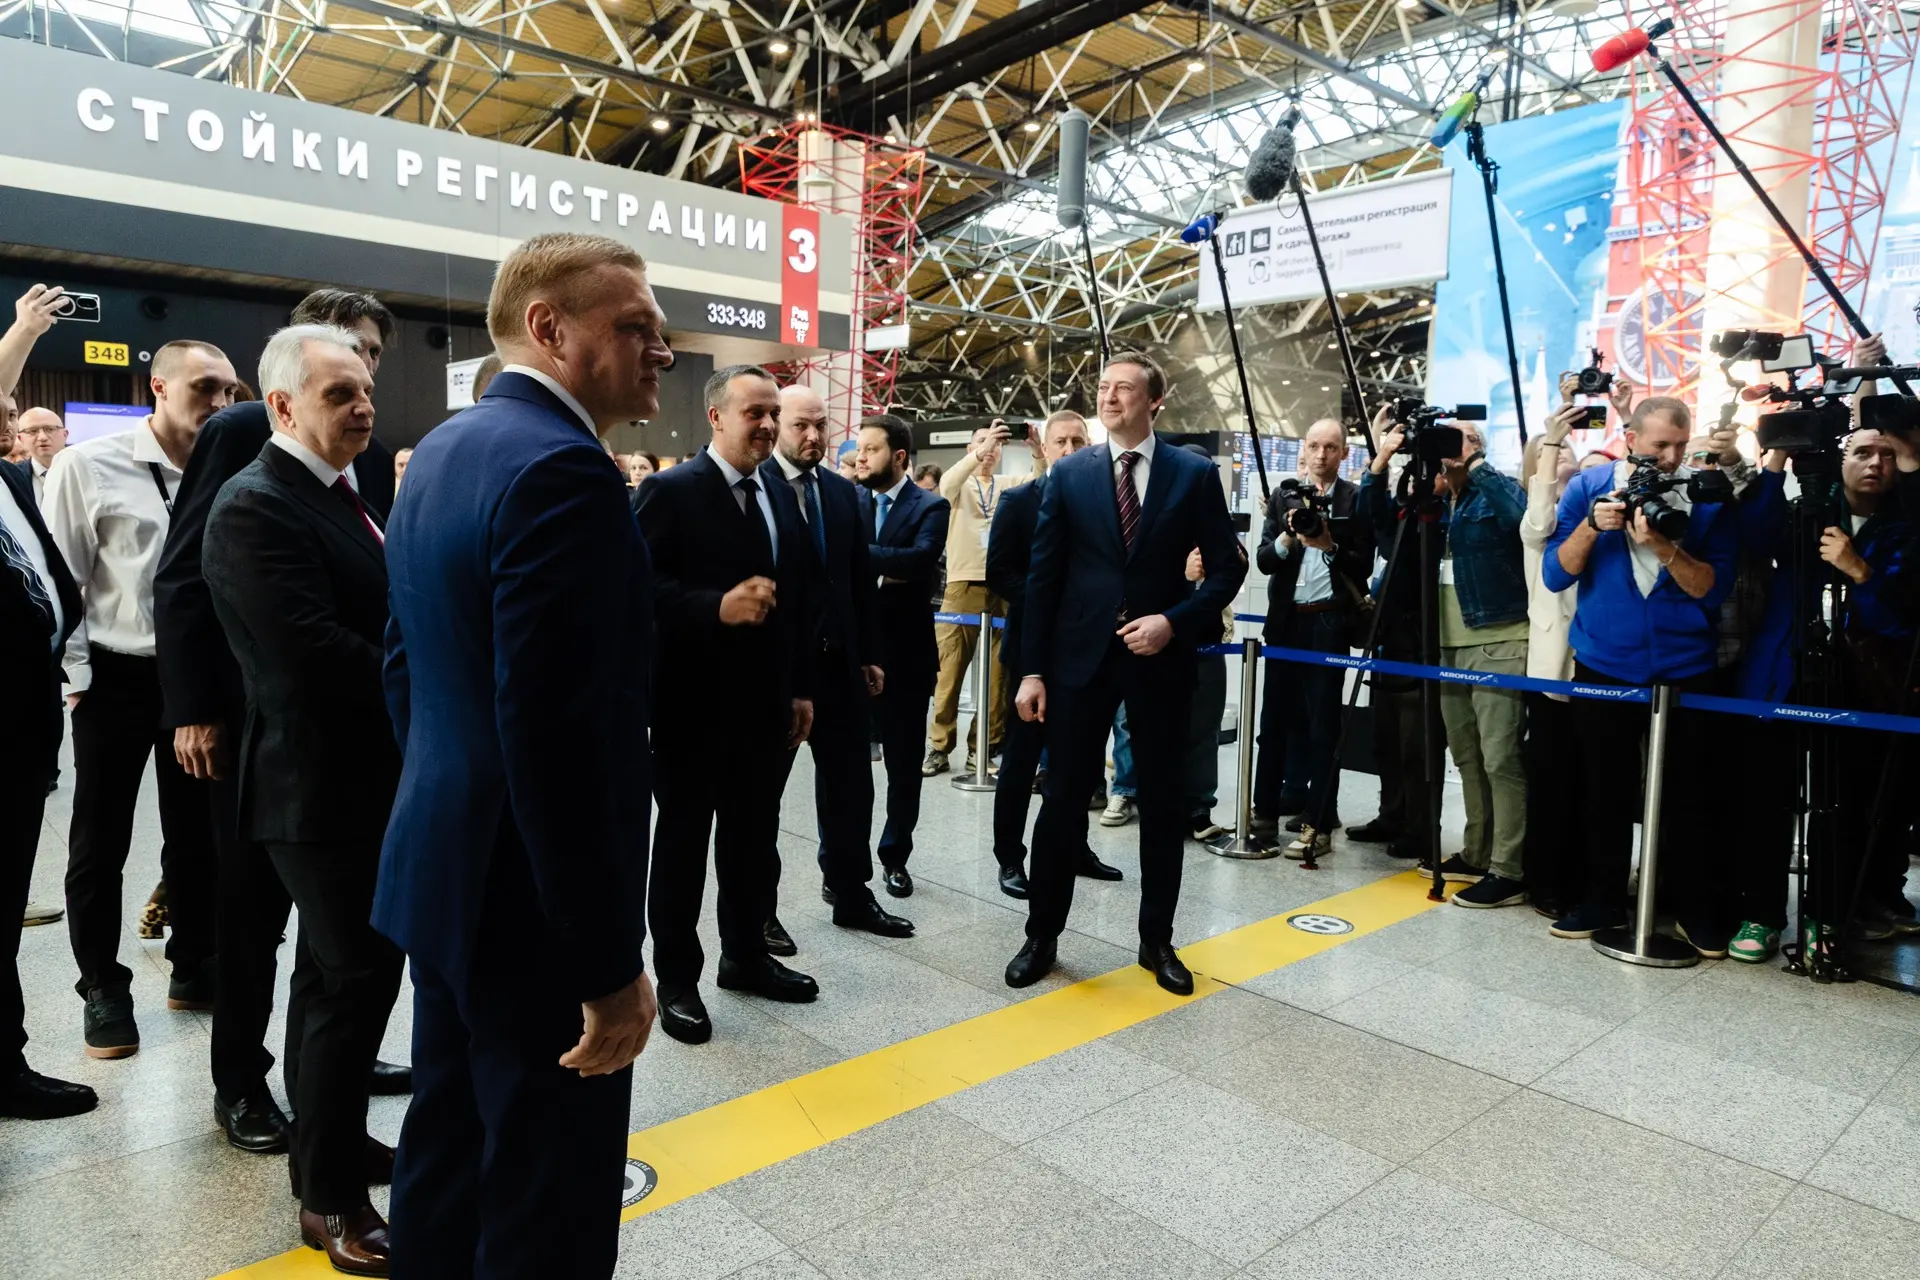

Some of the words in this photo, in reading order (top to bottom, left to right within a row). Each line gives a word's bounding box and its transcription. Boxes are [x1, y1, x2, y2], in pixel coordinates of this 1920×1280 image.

[76, 87, 369, 180] СТОЙКИ
[396, 148, 767, 252] РЕГИСТРАЦИИ
[1277, 214, 1365, 236] Самосоятельная
[1367, 201, 1438, 222] регистрация
[788, 227, 817, 273] 3
[707, 302, 766, 329] 333-348
[88, 345, 126, 362] 348
[1325, 656, 1361, 667] AEROFLOT
[1439, 671, 1480, 681] AEROFLOT
[1572, 686, 1623, 697] AEROFLOT
[1773, 707, 1831, 720] AEROFLOT
